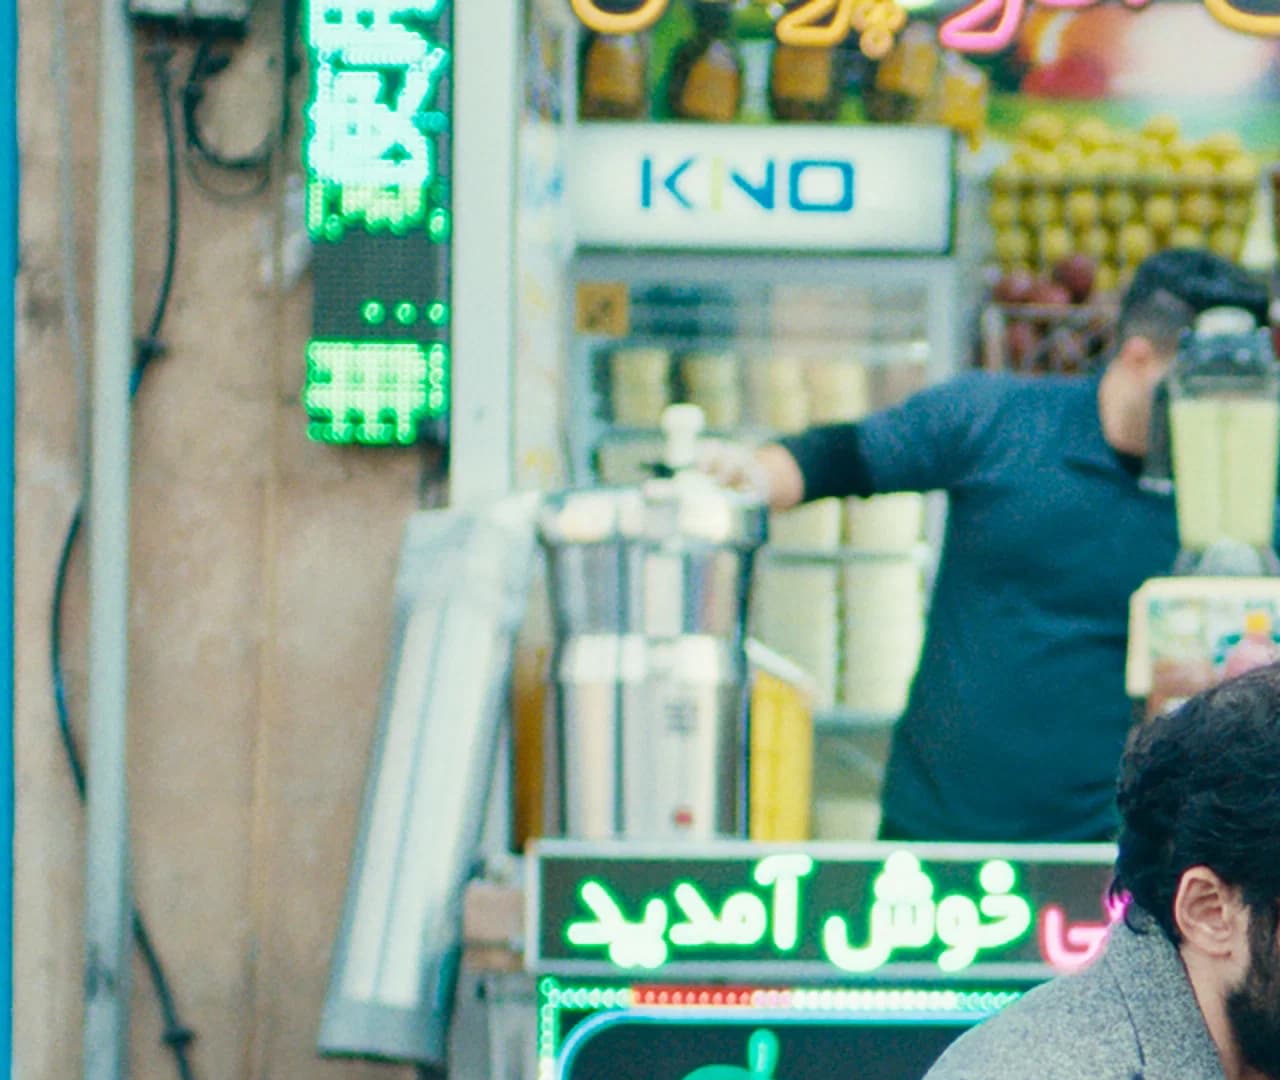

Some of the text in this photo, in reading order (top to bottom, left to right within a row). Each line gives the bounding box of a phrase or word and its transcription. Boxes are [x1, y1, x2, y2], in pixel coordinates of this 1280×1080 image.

[639, 154, 855, 212] KINO
[567, 853, 814, 968] آمدید
[823, 849, 1032, 972] خوش
